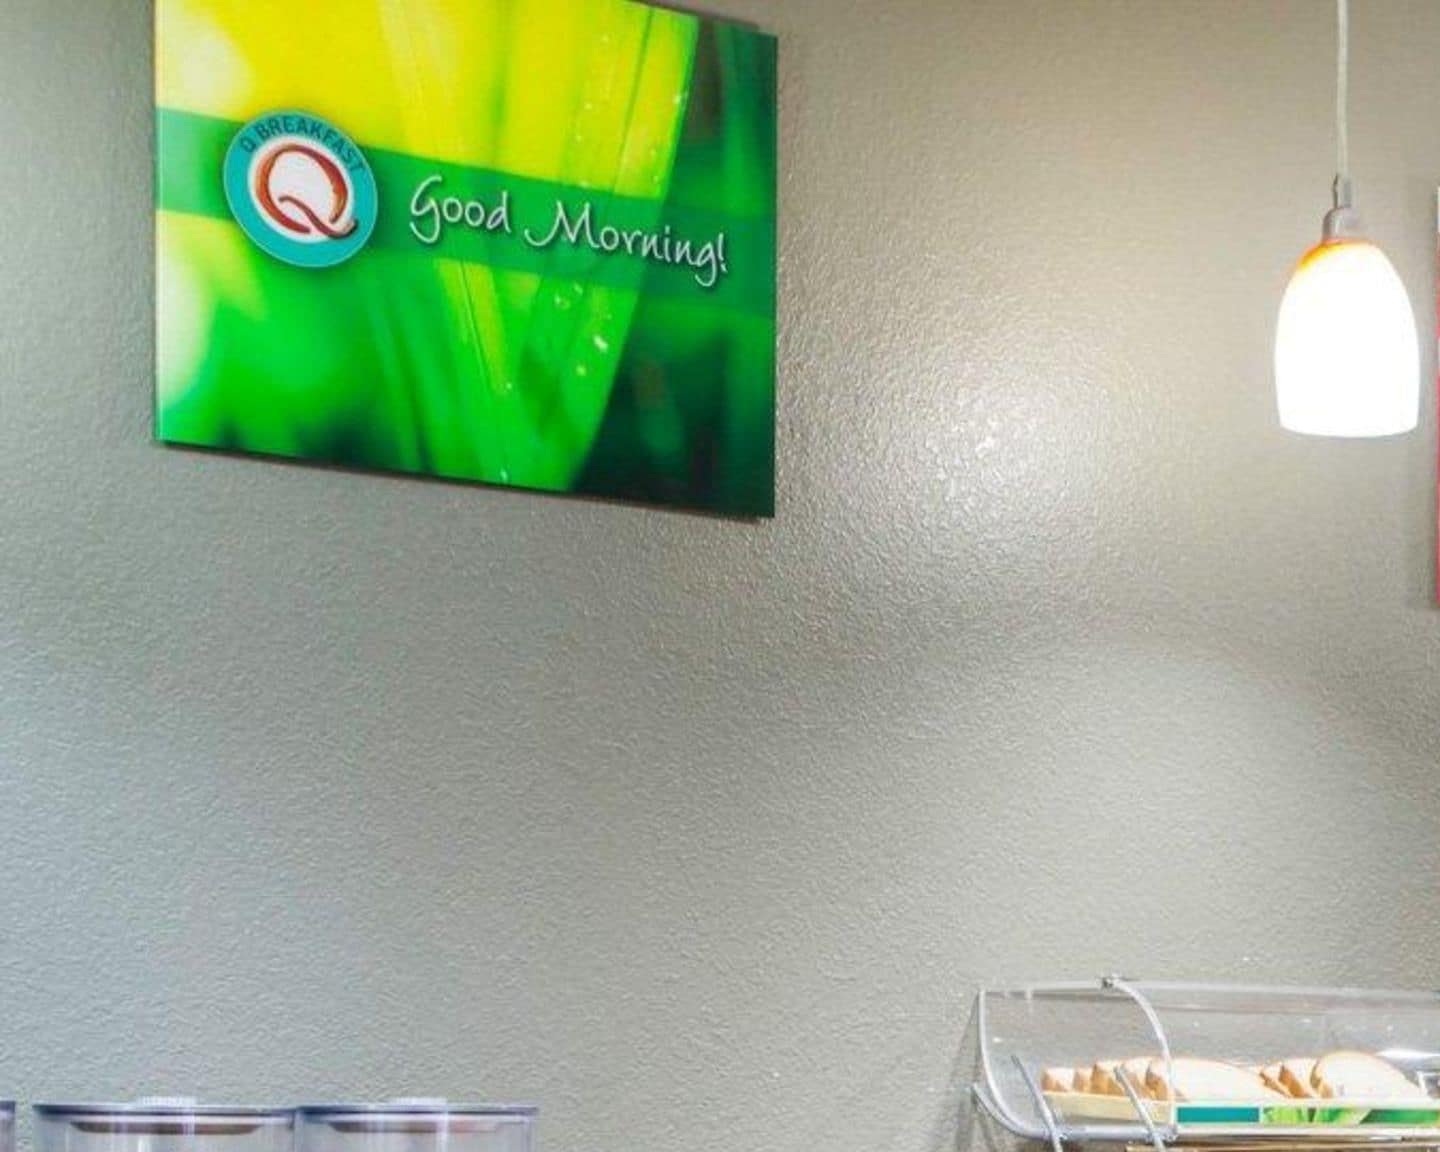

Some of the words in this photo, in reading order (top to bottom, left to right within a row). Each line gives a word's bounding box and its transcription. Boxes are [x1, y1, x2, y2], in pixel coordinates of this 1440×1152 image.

[253, 117, 367, 173] BREAKFAST
[254, 143, 360, 239] Q
[409, 174, 512, 244] Good
[523, 200, 728, 287] Morning!
